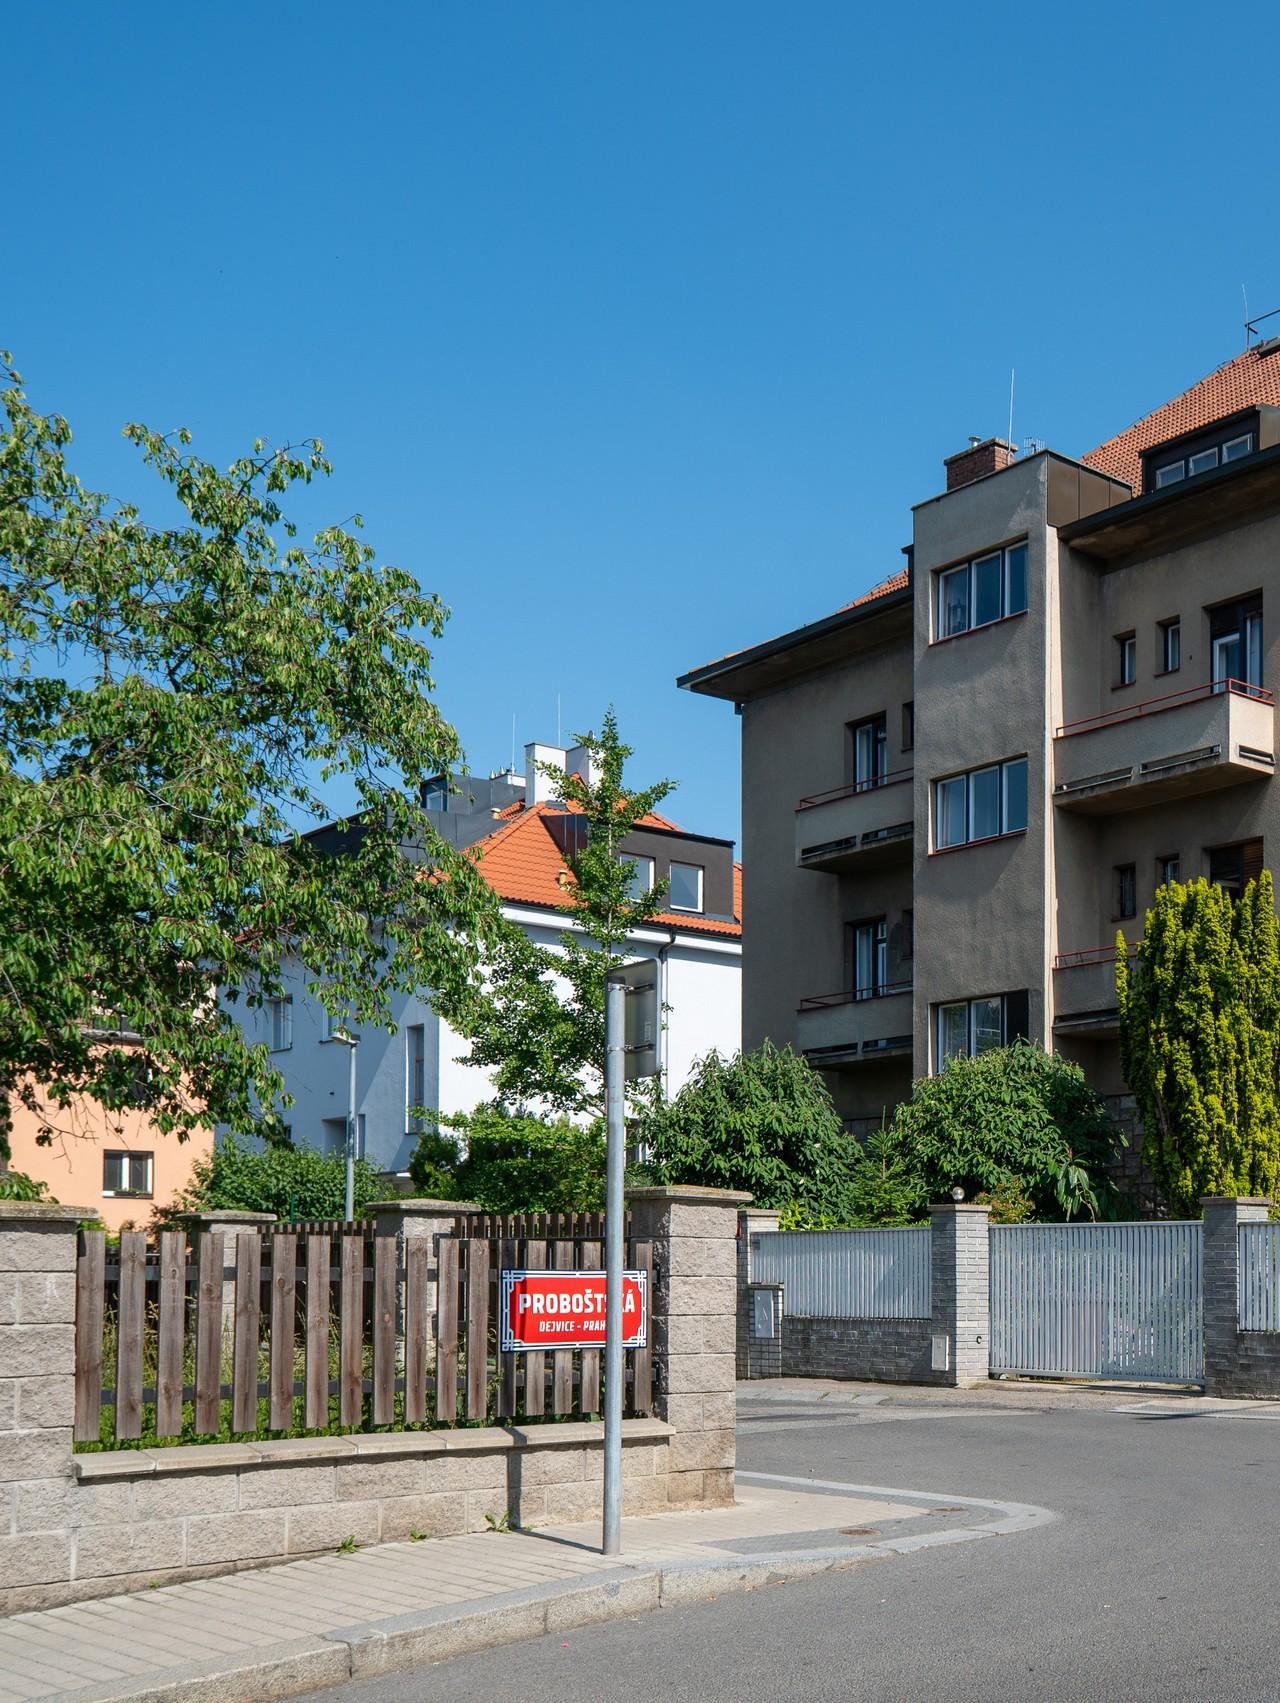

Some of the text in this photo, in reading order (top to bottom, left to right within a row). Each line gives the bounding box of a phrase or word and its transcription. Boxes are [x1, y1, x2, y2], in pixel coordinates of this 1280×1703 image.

[519, 1289, 635, 1314] PROBOŠTÁ
[539, 1321, 575, 1332] DEJVICE
[583, 1320, 606, 1331] PRAH
